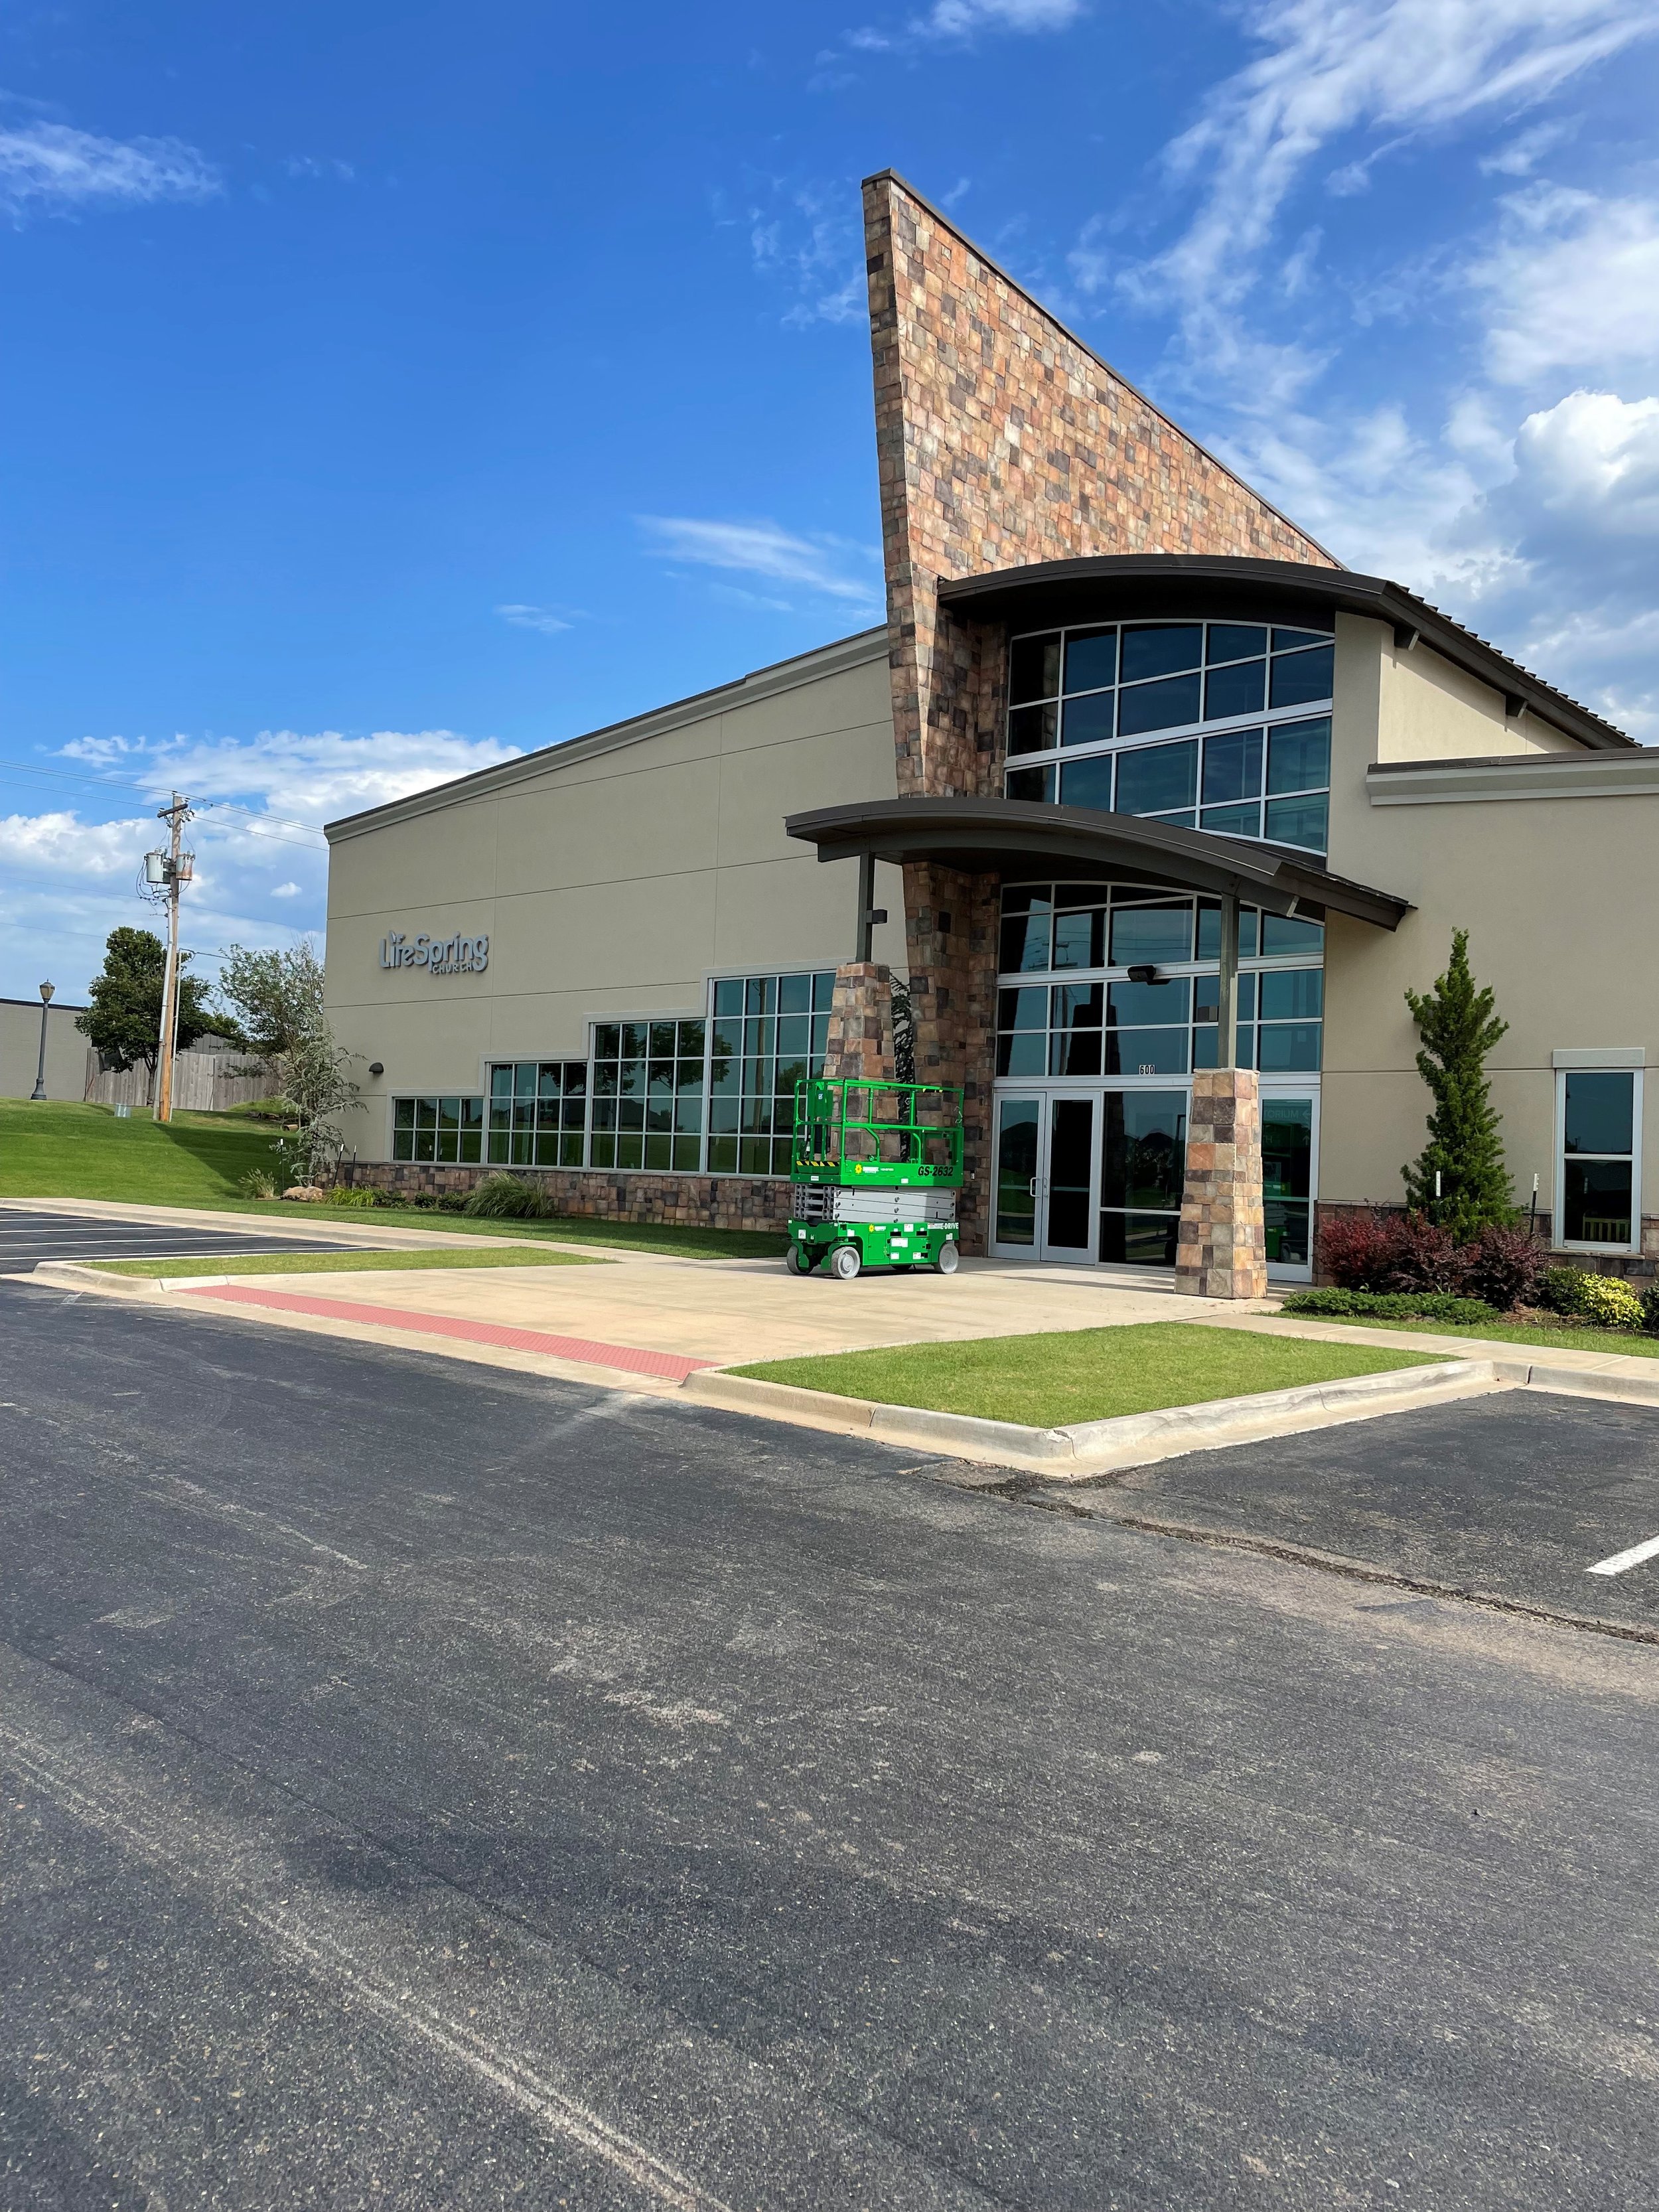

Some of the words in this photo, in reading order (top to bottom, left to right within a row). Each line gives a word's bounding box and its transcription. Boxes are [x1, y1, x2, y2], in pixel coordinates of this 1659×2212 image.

[379, 930, 489, 972] LifeSpring
[433, 962, 474, 974] CHURCH
[1140, 1065, 1154, 1074] 600
[918, 1165, 954, 1177] GS-2632
